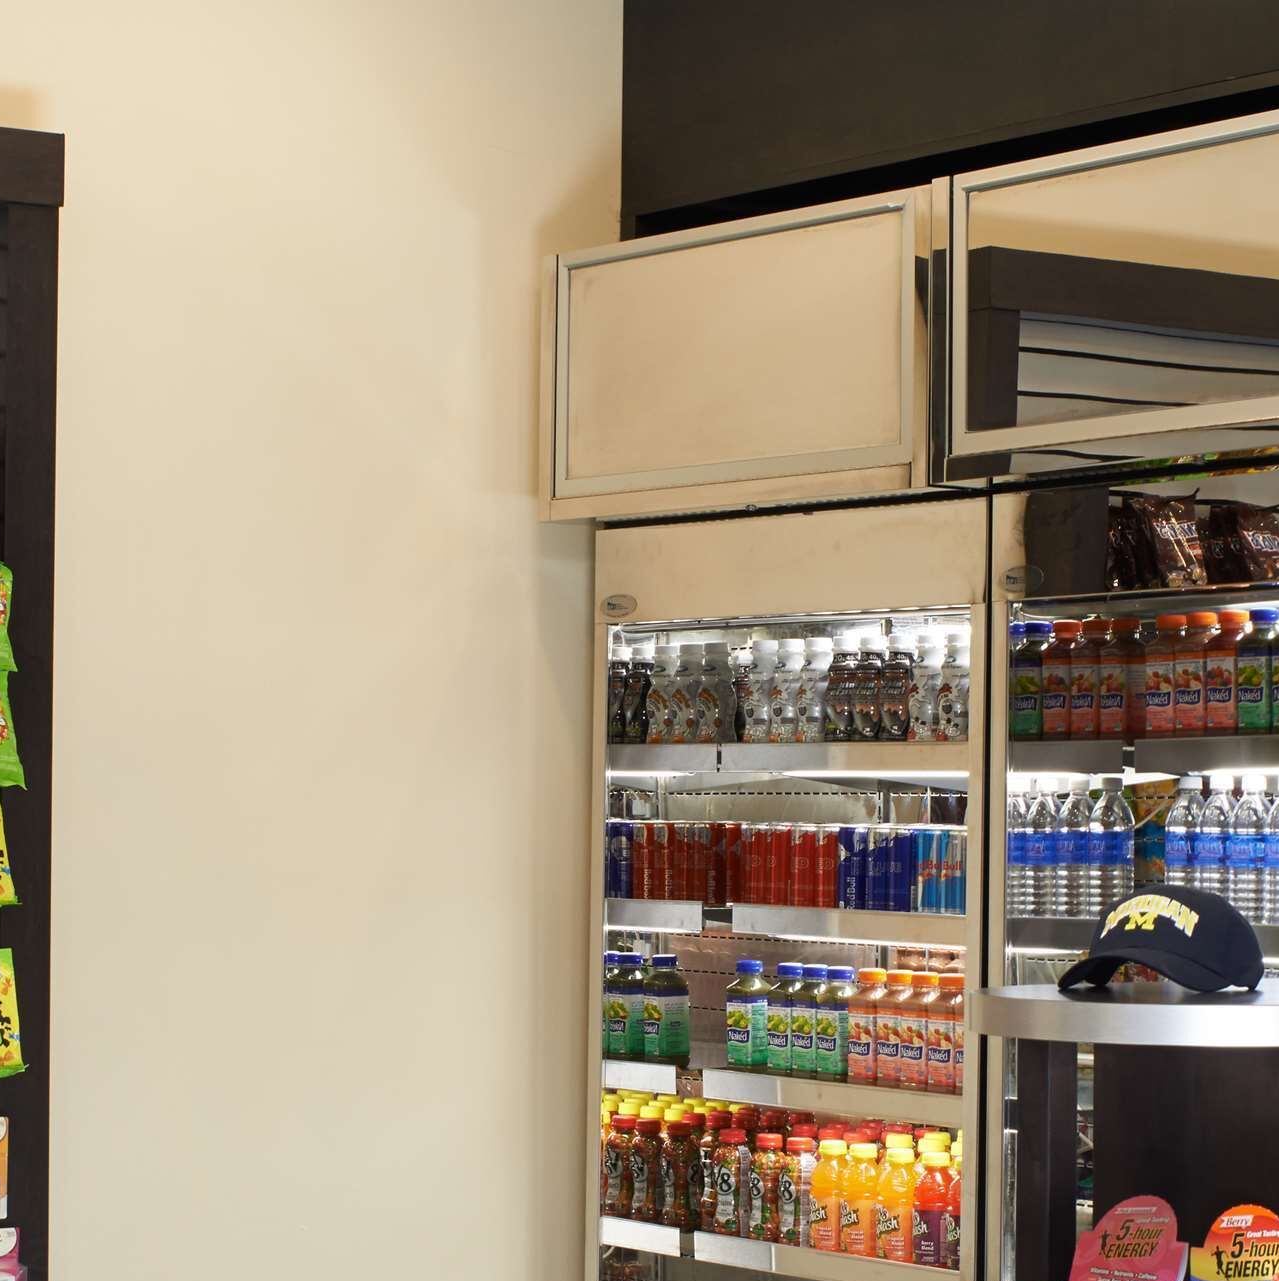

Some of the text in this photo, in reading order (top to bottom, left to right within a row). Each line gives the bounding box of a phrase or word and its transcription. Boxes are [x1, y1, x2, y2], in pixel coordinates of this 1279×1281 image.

[1116, 1219, 1165, 1242] 5-hour
[1225, 1216, 1250, 1227] Berry
[1105, 1242, 1159, 1260] ENERGY
[1225, 1258, 1279, 1280] ENERGY
